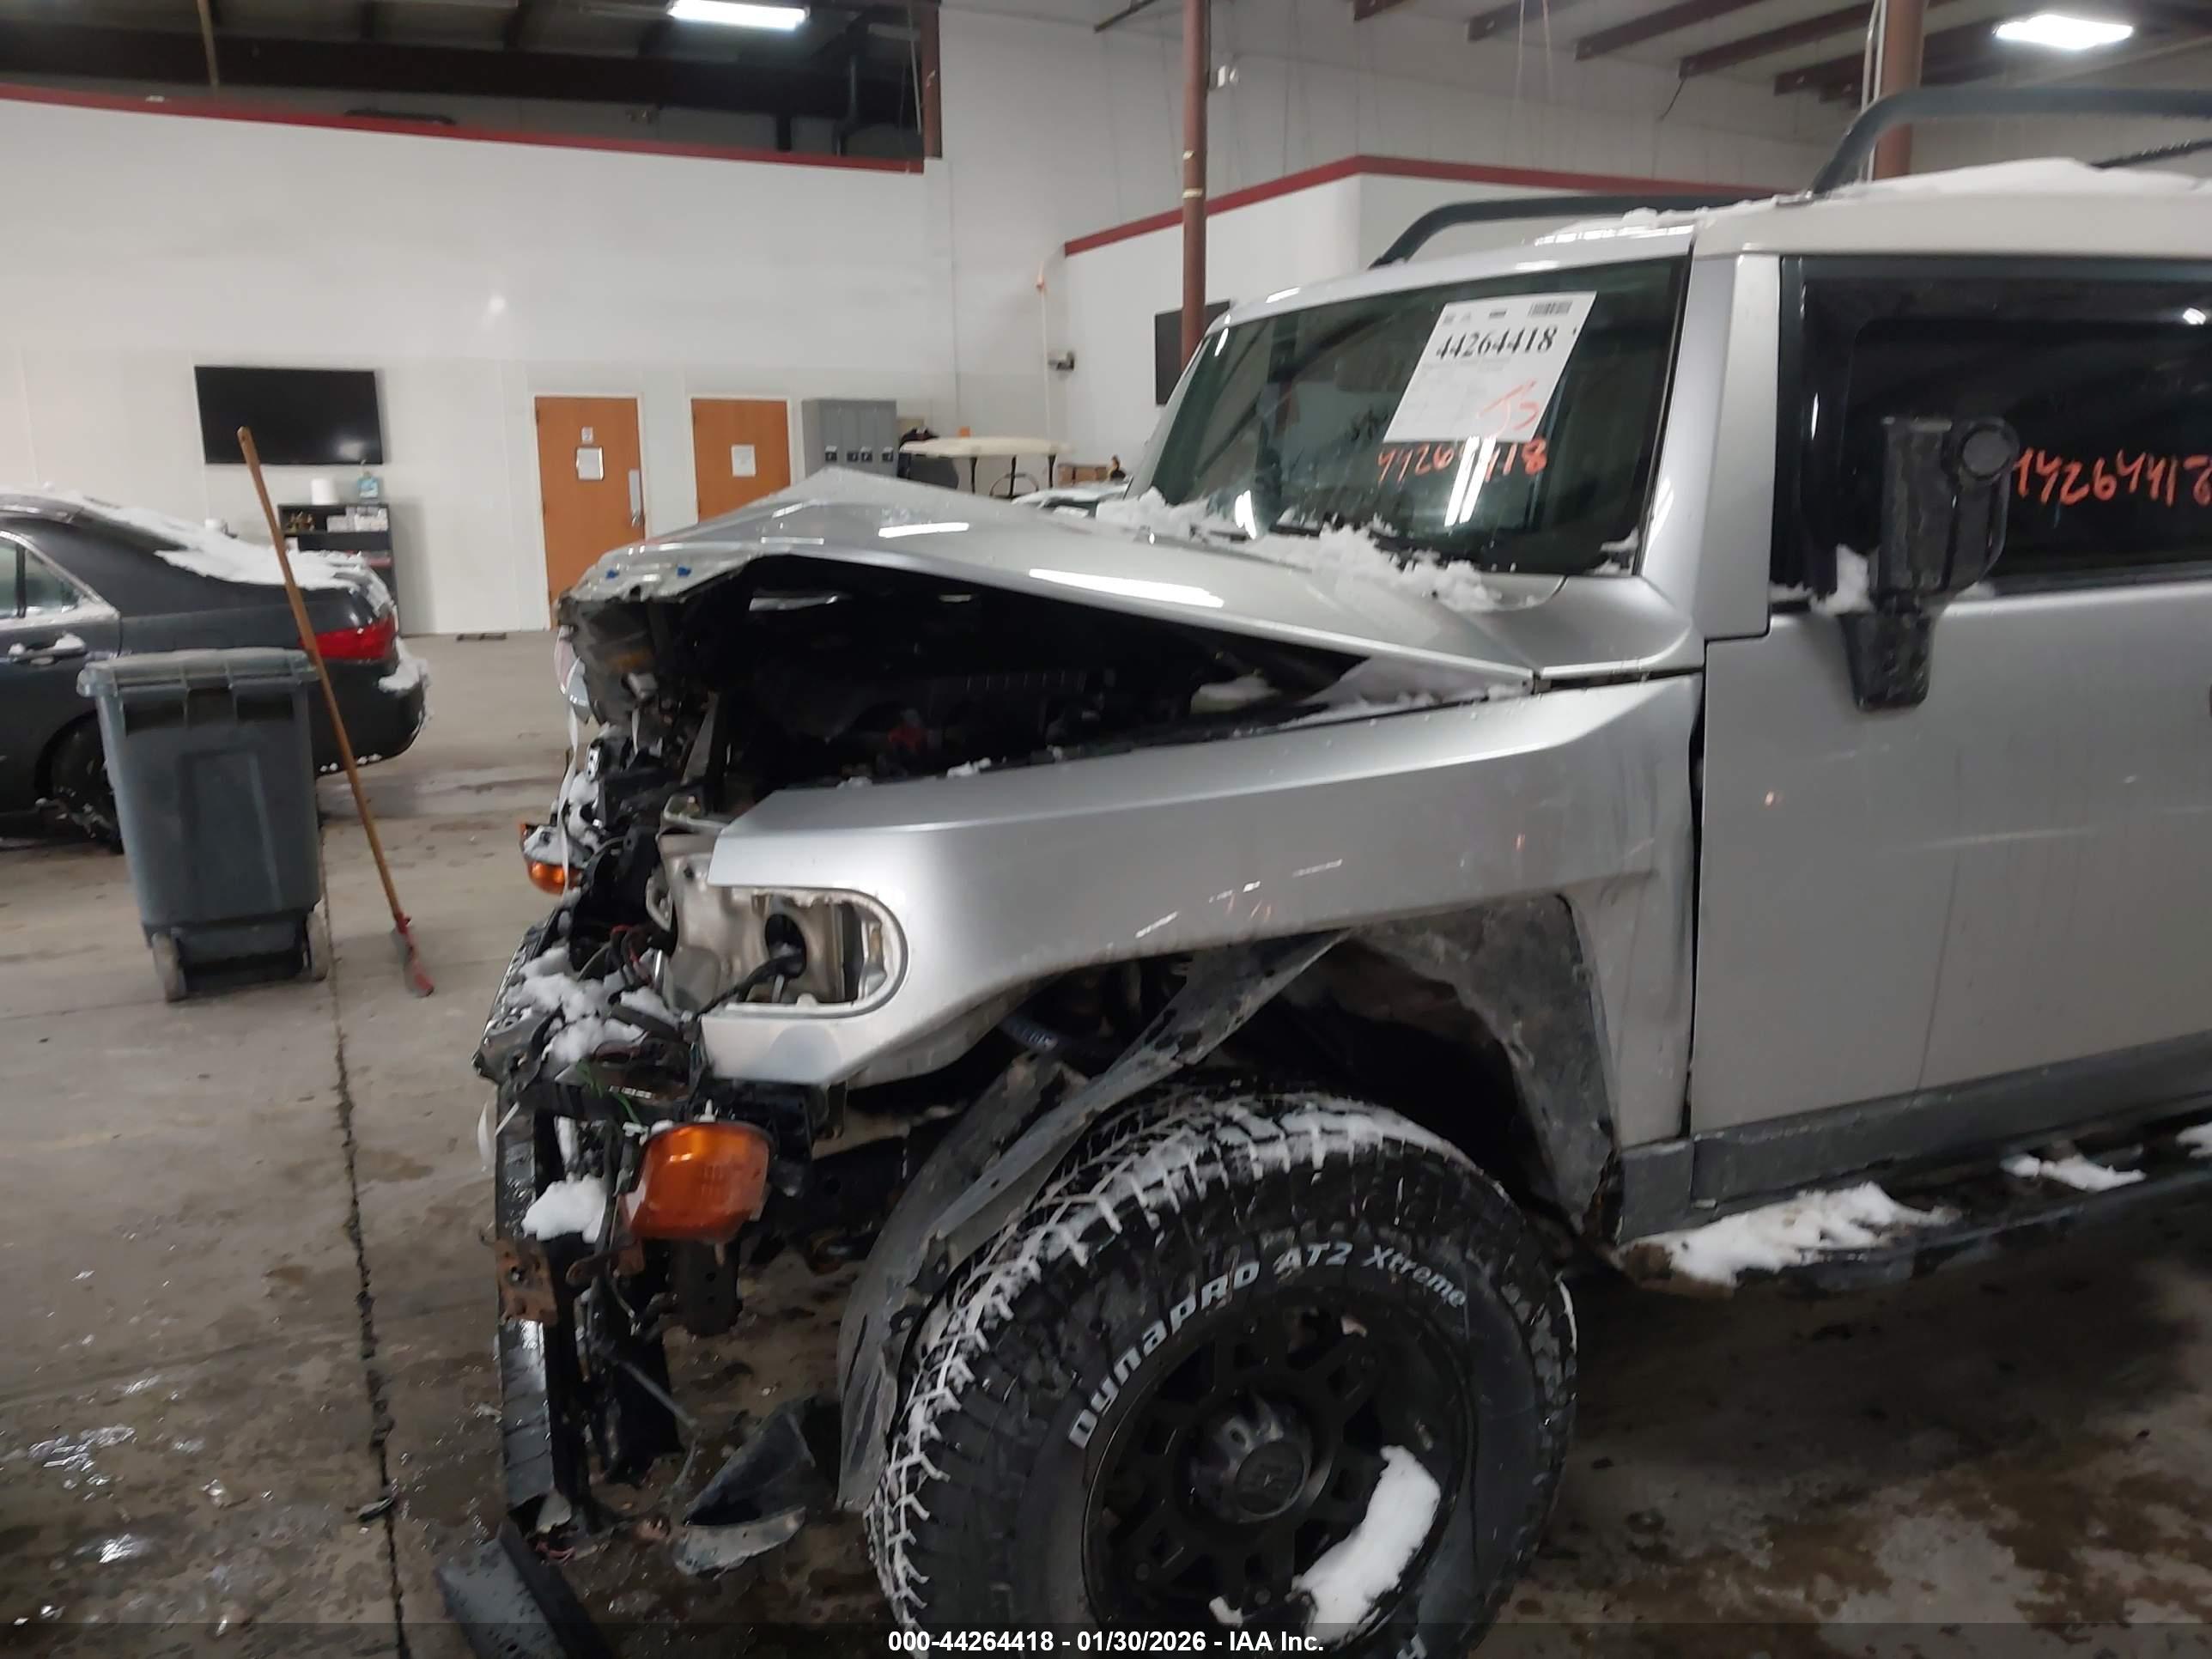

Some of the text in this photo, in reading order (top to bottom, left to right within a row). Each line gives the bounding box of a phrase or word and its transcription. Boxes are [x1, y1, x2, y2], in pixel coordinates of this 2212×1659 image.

[1436, 325, 1559, 360] 44264418
[1273, 1242, 1353, 1275] AT2
[1364, 1243, 1468, 1309] Xtreme
